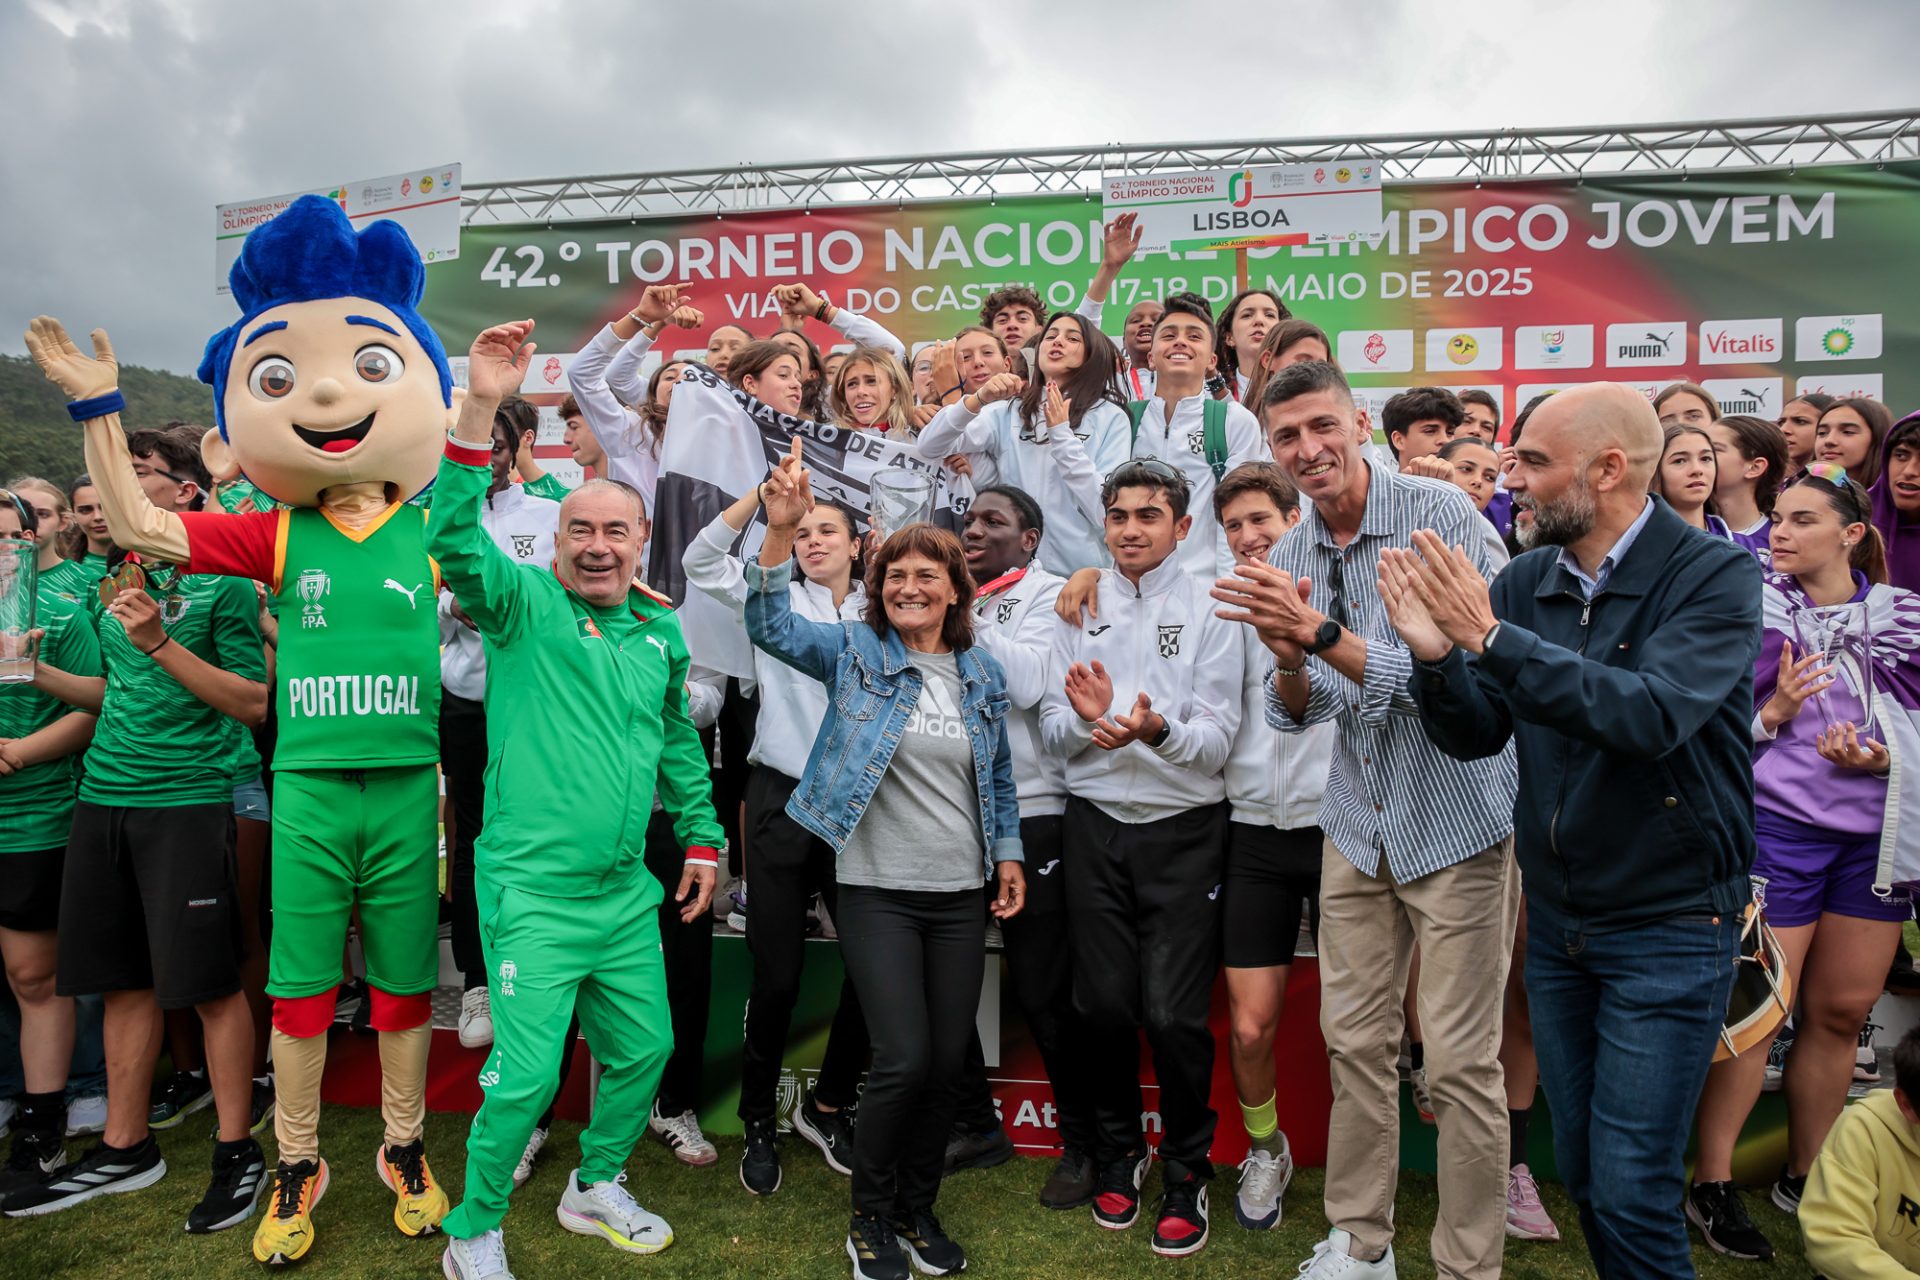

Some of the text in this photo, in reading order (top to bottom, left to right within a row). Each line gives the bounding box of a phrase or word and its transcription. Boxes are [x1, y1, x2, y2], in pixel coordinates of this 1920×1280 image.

[1111, 184, 1215, 200] OLÍMPICO JOVEM
[1128, 179, 1167, 189] TORNEIO
[1169, 176, 1216, 185] NACIONAL
[1193, 208, 1291, 232] LISBOA
[596, 229, 864, 284] TORNEIO
[884, 219, 1218, 272] NACIO
[1586, 191, 1835, 250] JOVEM
[847, 287, 900, 315] DO
[1266, 272, 1367, 301] MAIO
[1380, 271, 1432, 299] DE
[1443, 267, 1534, 298] 2025
[1841, 317, 1855, 327] bp
[1619, 344, 1662, 358] PUMA
[1707, 330, 1775, 354] Vitalis
[848, 432, 885, 462] DE
[302, 615, 328, 629] FPA
[289, 674, 421, 718] PORTUGAL
[501, 987, 516, 997] FPA
